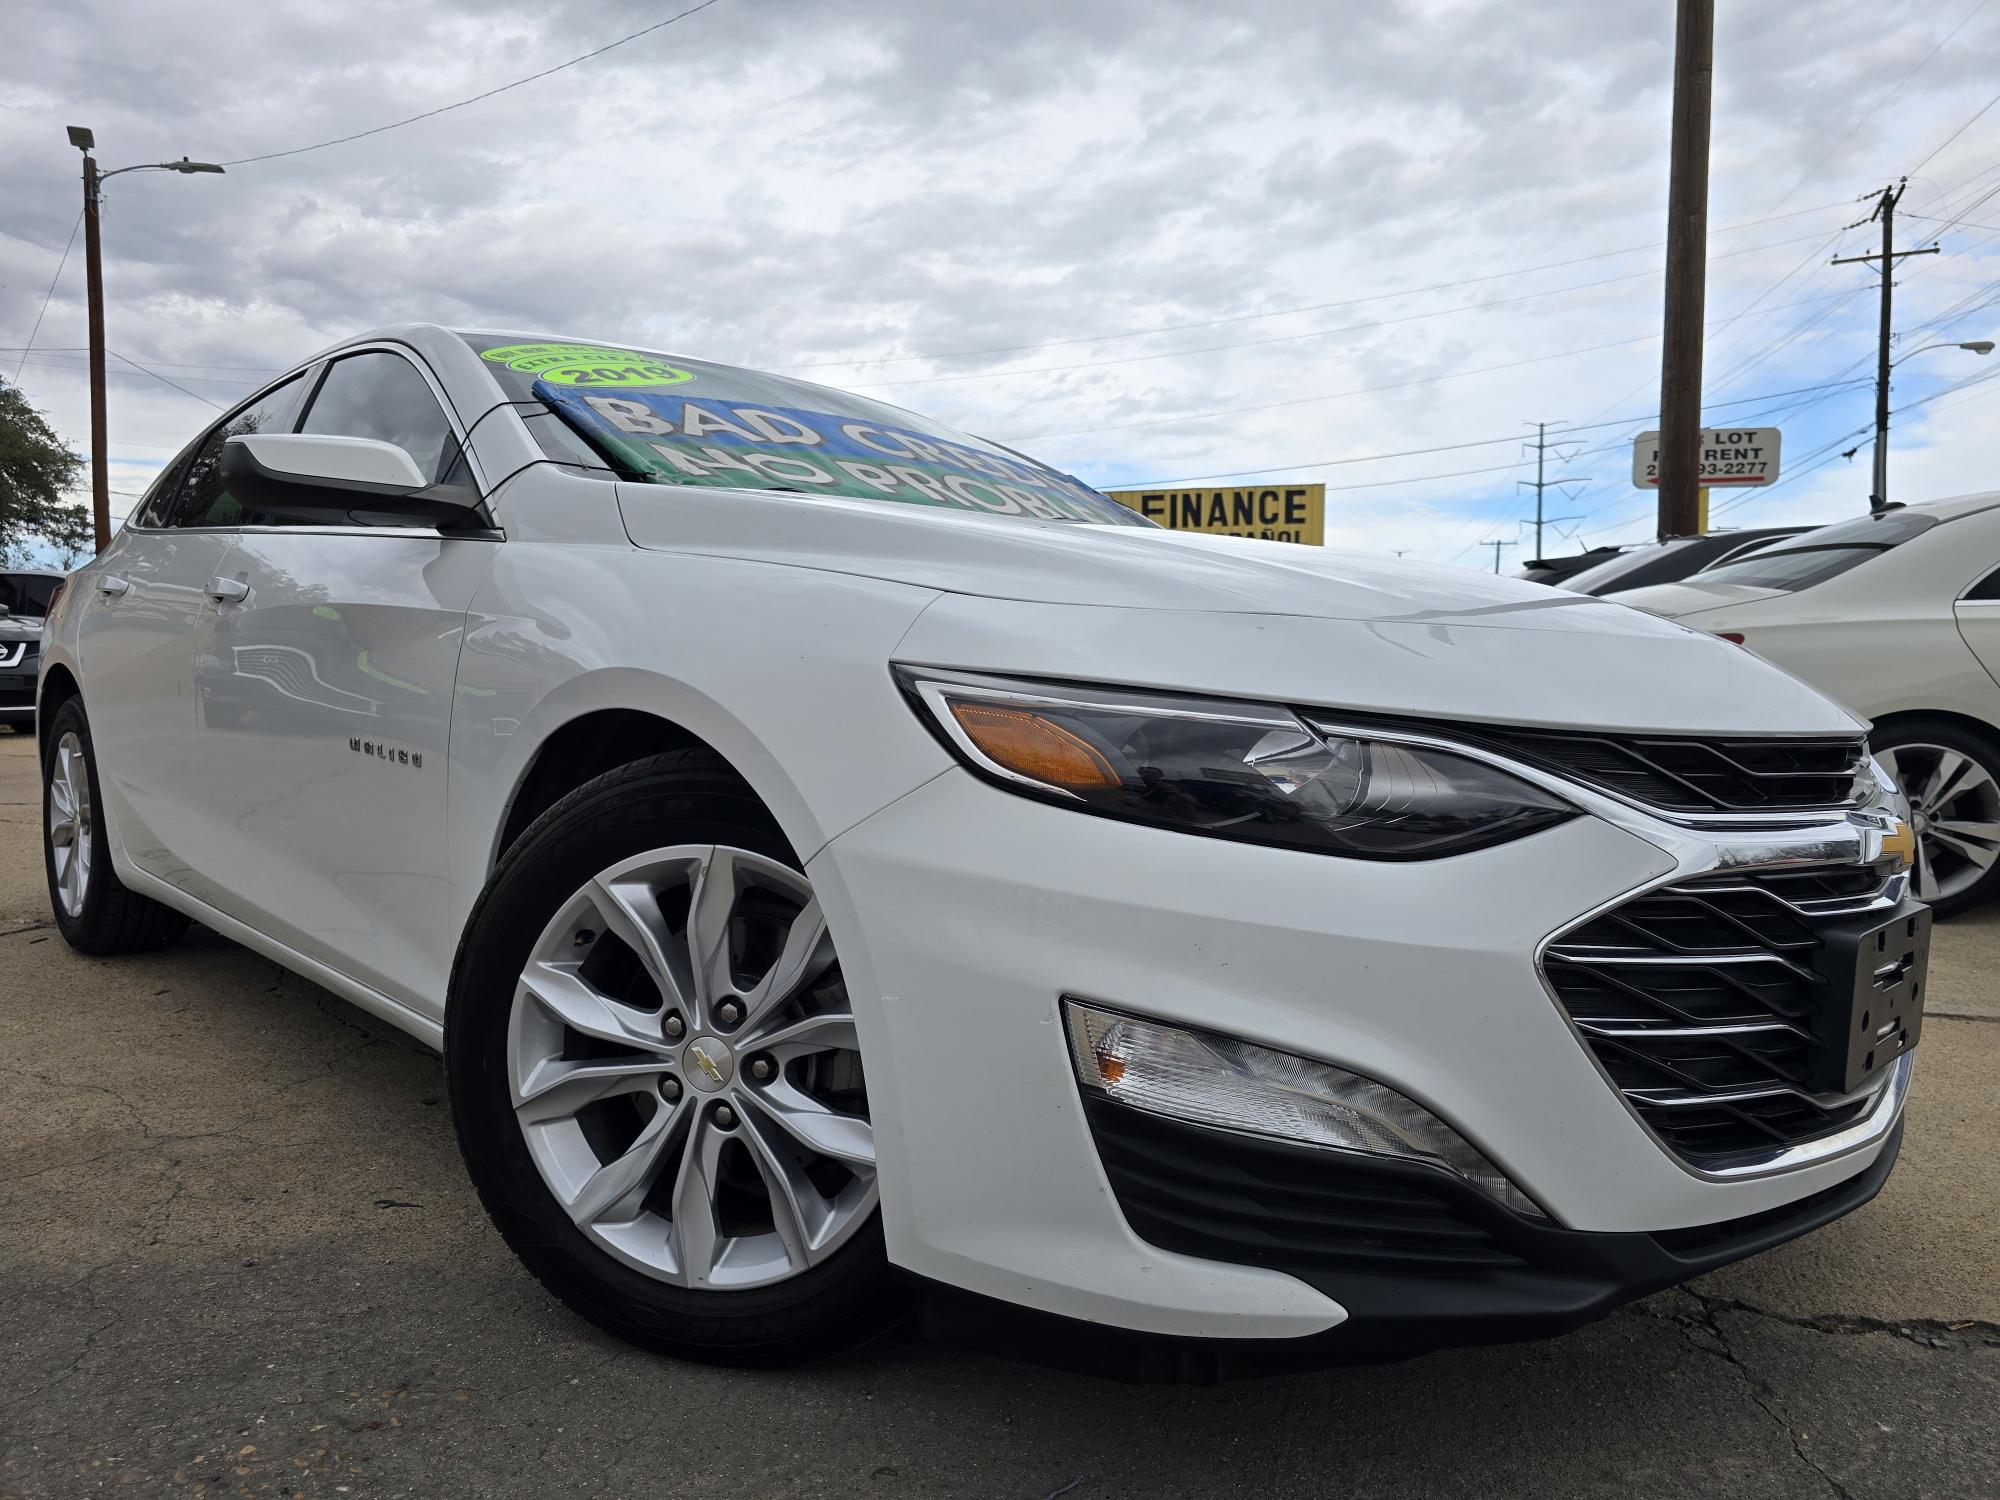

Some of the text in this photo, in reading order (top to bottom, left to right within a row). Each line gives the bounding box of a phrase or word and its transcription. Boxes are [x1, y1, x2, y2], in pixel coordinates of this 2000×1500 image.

[515, 355, 579, 370] EXTRA
[560, 367, 679, 384] 2019
[582, 396, 821, 445] BAD
[1715, 432, 1757, 445] LOT
[1704, 447, 1763, 461] RENT
[650, 443, 835, 485] NO
[1142, 490, 1307, 529] FINANCE
